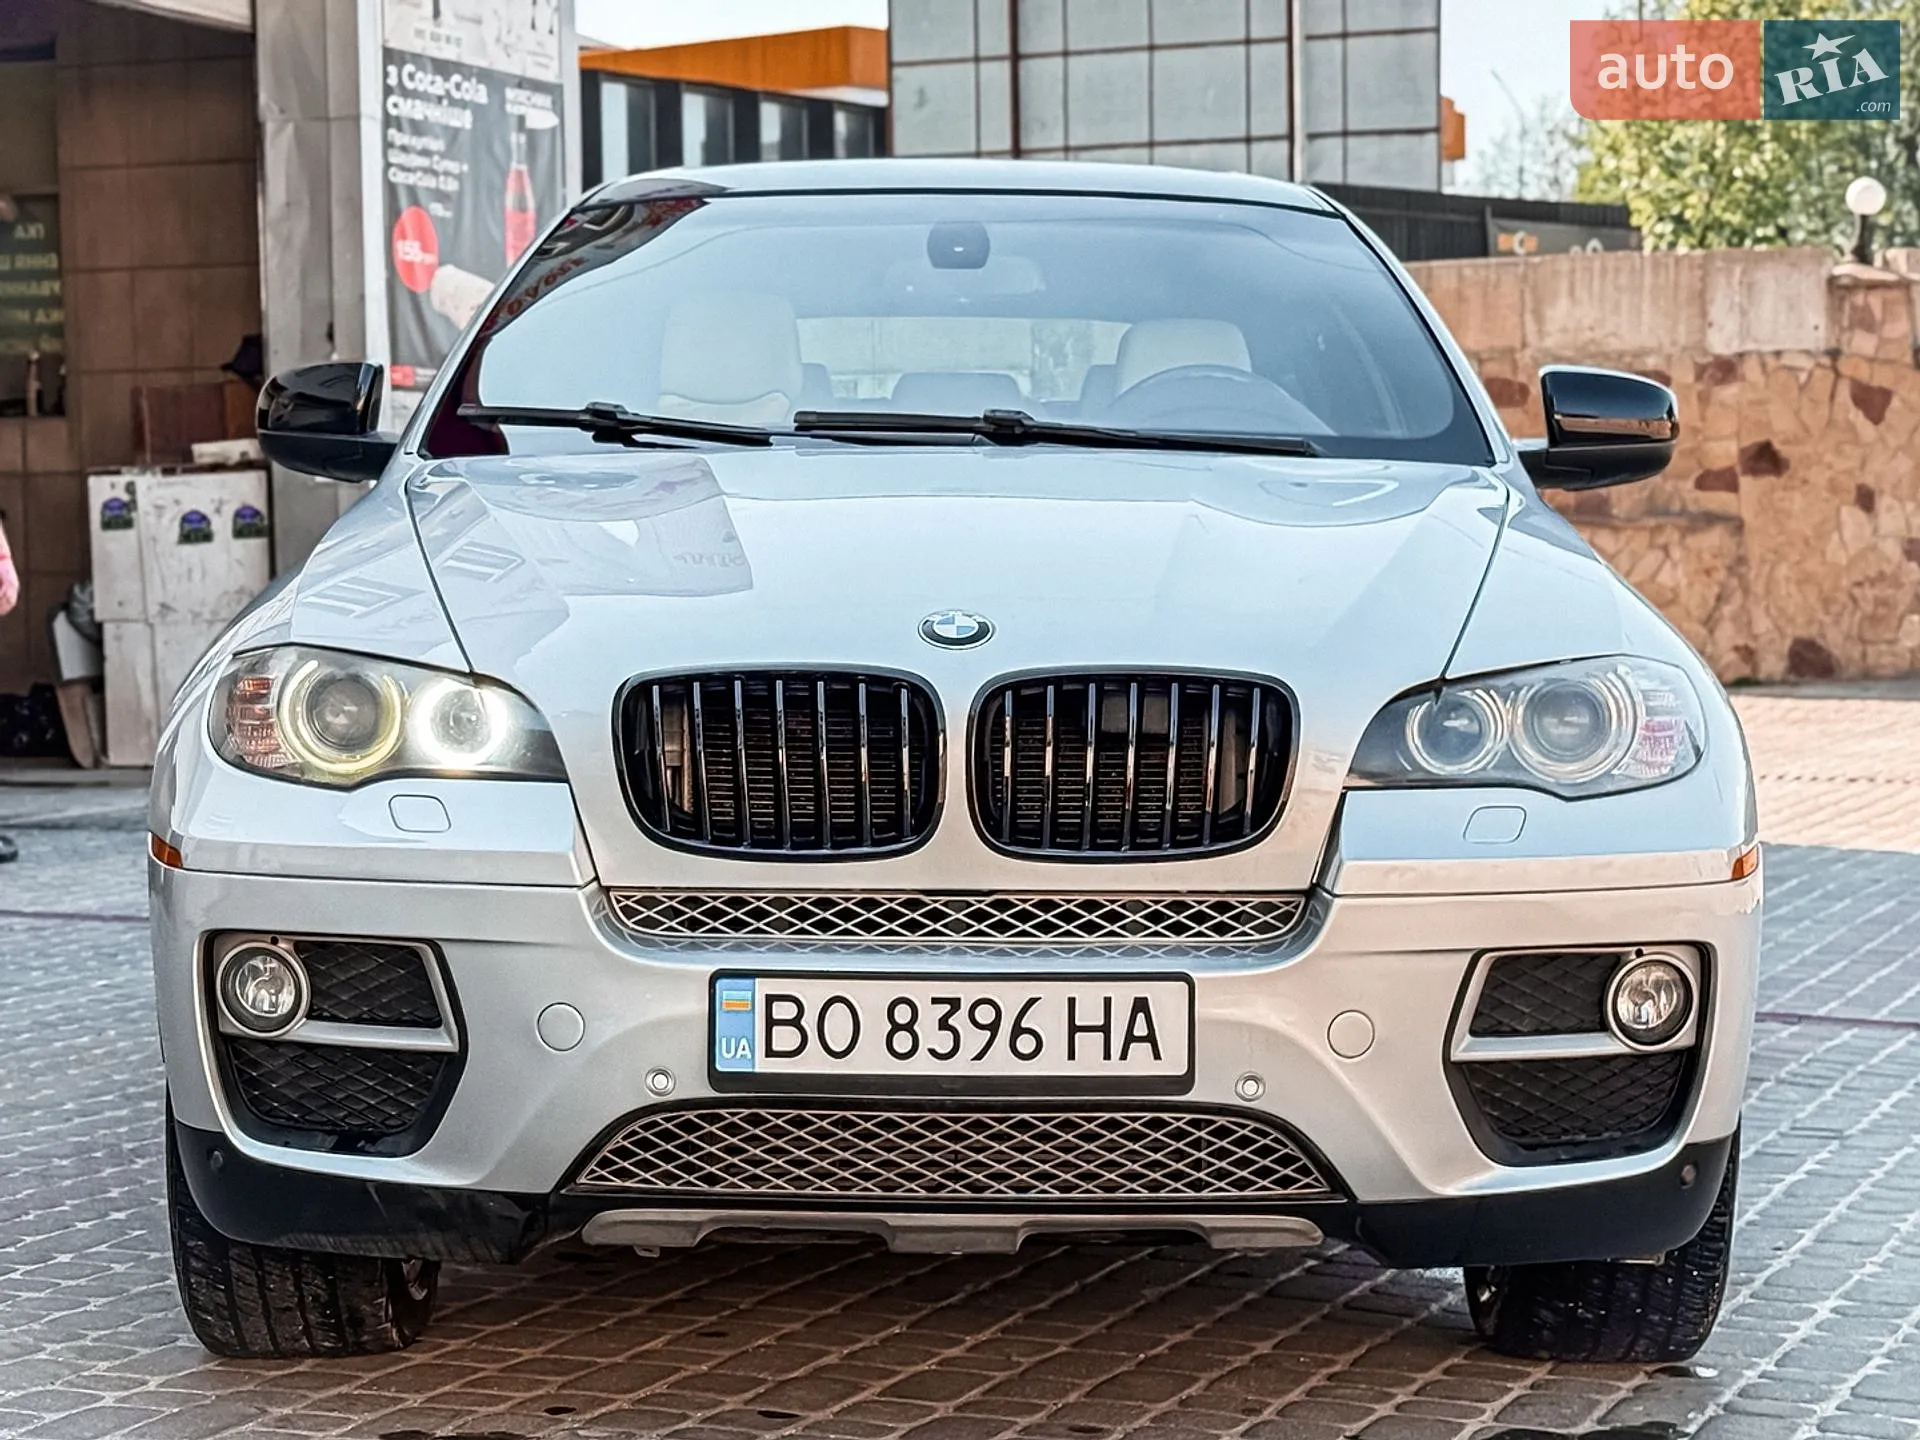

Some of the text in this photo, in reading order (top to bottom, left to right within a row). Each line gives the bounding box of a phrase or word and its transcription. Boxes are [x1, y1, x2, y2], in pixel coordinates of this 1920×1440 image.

[721, 1036, 752, 1060] UA
[765, 993, 1162, 1062] BO 8396 HA
